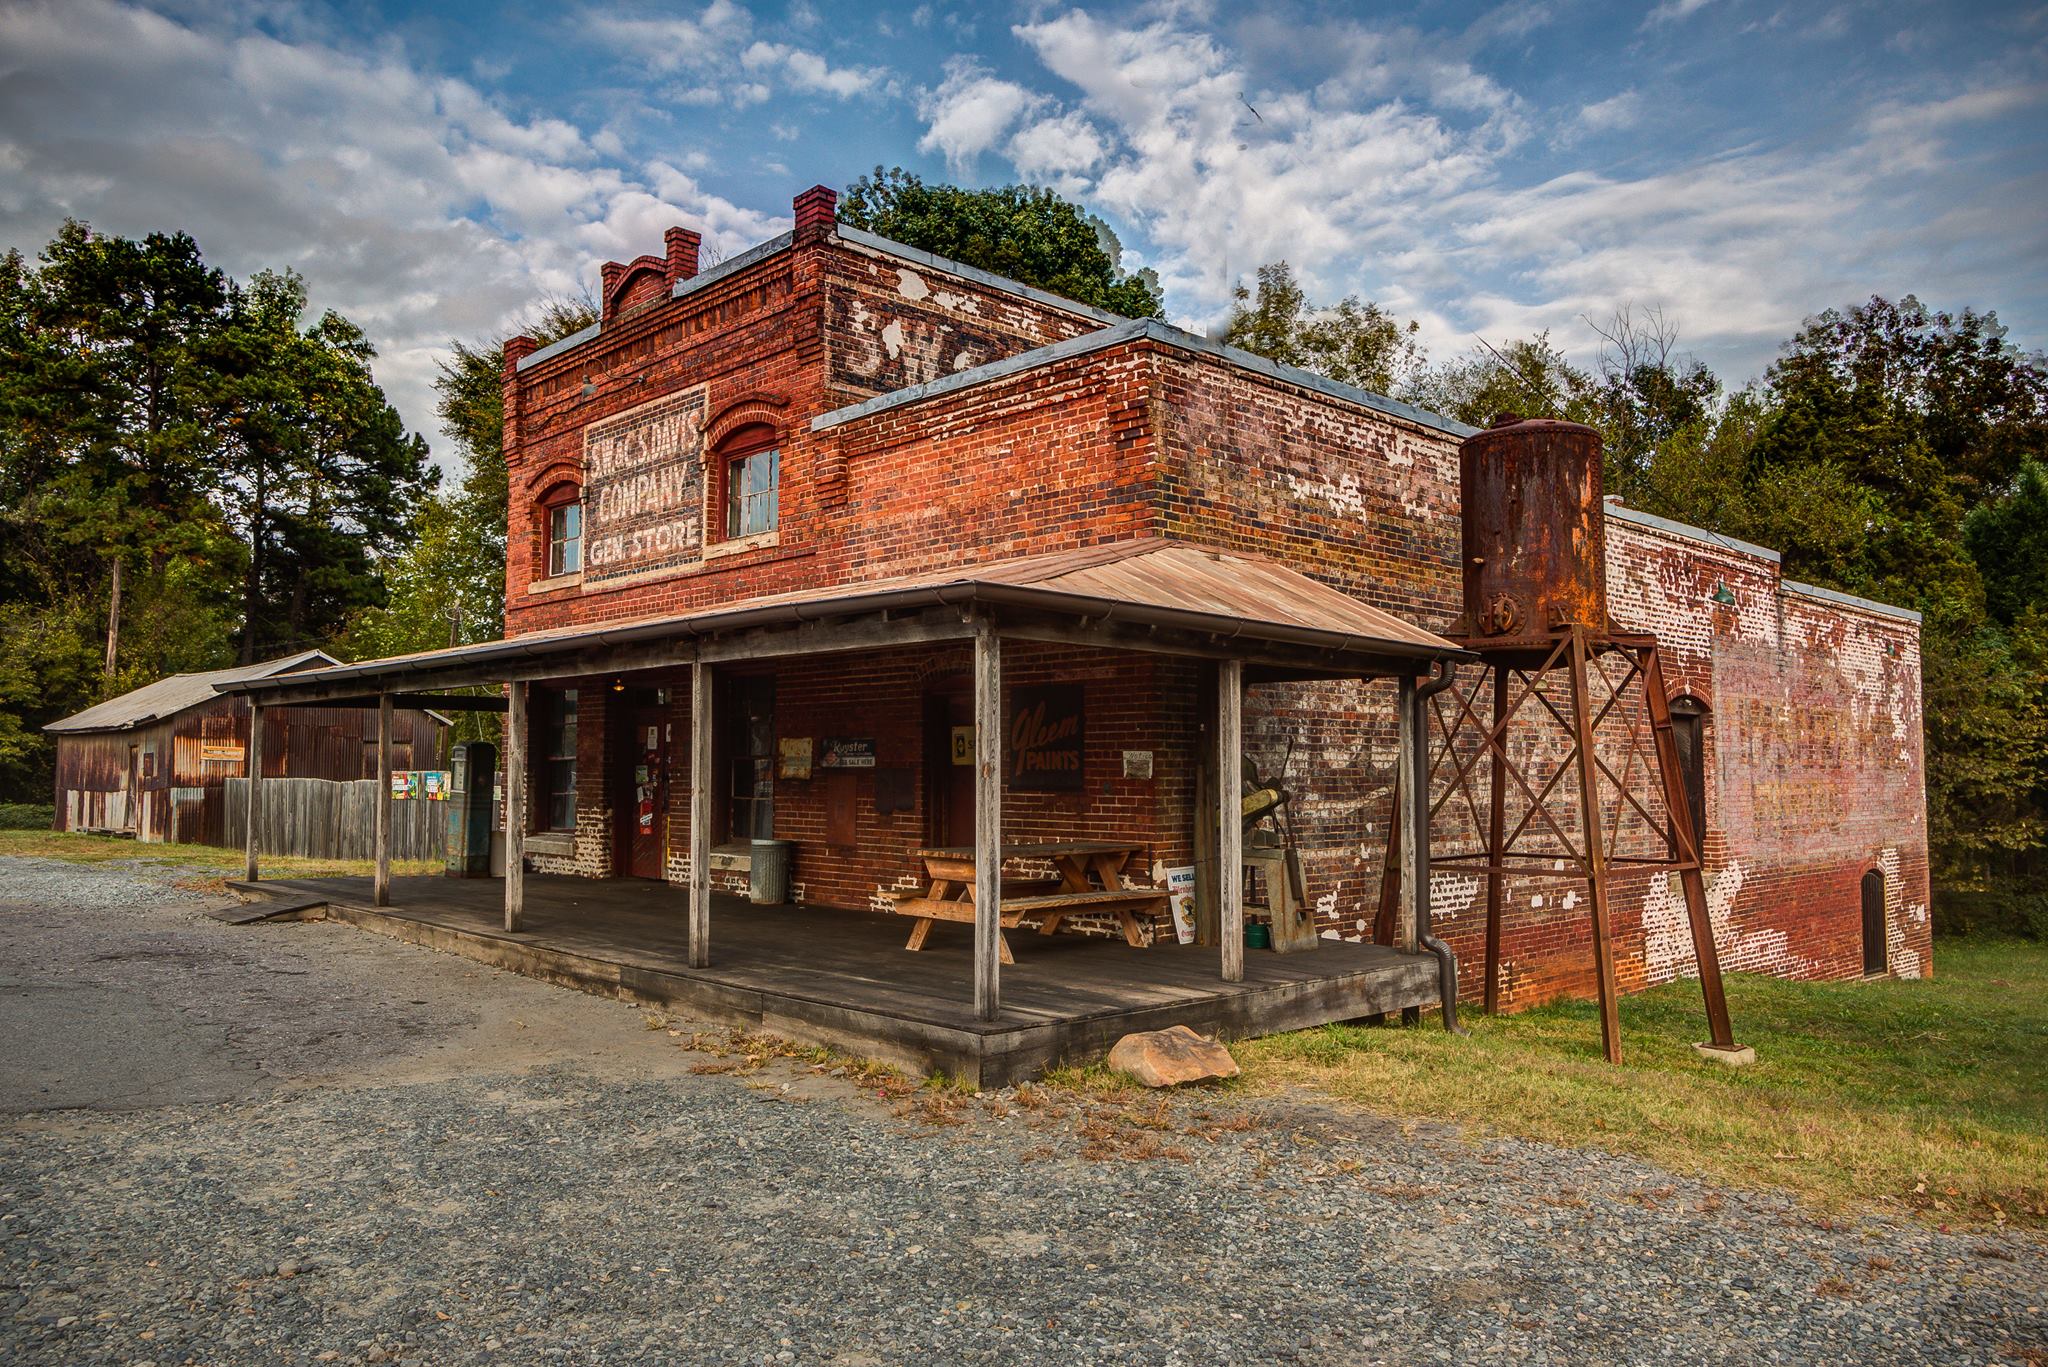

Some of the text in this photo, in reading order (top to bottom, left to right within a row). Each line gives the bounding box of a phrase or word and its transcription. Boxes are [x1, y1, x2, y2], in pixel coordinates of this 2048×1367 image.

[650, 410, 700, 461] DAVIS
[600, 462, 688, 522] COMPANY
[631, 516, 699, 559] STORE
[1011, 699, 1079, 777] Gleem
[1026, 750, 1080, 770] PAINTS
[1171, 874, 1182, 883] WE
